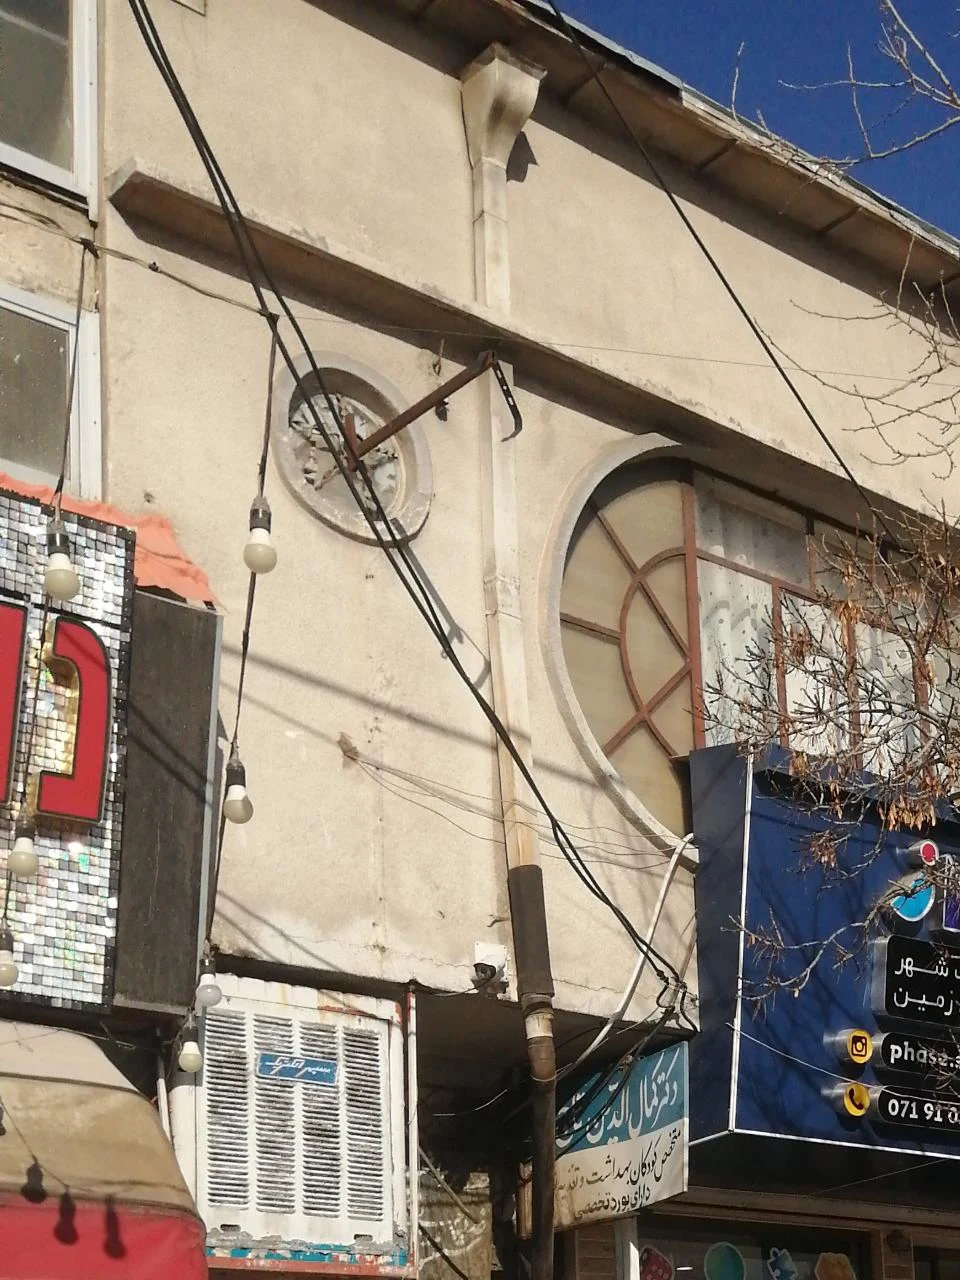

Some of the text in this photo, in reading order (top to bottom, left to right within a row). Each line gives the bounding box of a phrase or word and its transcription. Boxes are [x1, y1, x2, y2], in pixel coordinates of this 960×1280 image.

[895, 957, 949, 978] شهر
[894, 987, 954, 1016] زمین
[628, 1050, 665, 1139] کمال
[650, 1047, 681, 1129] دکتر
[887, 1098, 919, 1119] 071
[923, 1102, 943, 1123] 91
[586, 1154, 632, 1186] بهداشت
[629, 1133, 662, 1186] کودکان
[653, 1127, 682, 1183] متخصص
[630, 1183, 651, 1209] دارای
